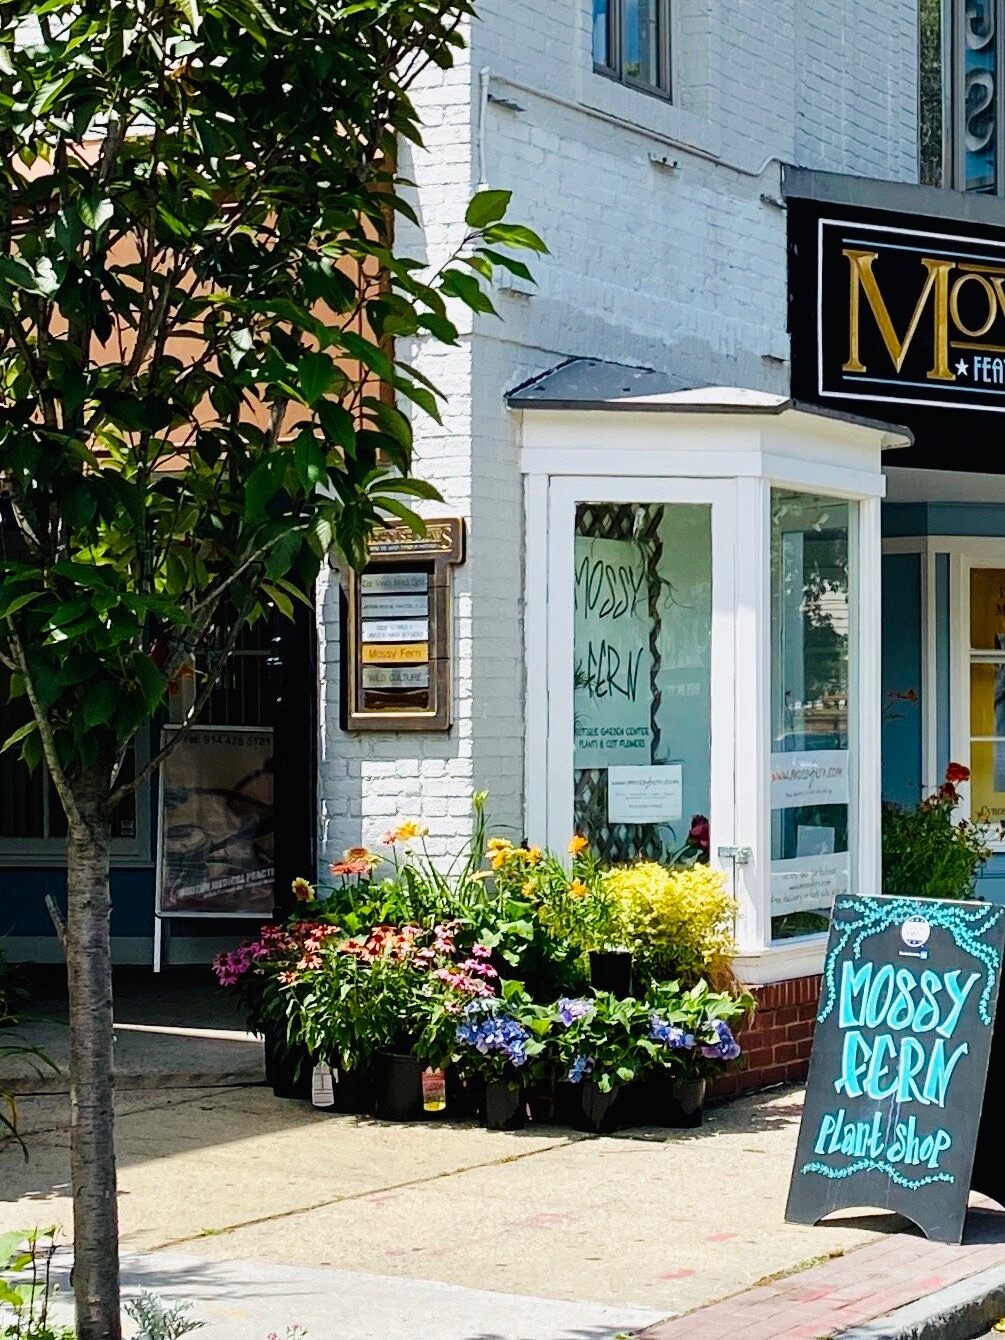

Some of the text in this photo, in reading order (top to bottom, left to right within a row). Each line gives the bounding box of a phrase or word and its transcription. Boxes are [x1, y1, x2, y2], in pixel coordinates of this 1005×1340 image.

[368, 648, 421, 659] Mossy Fern
[587, 639, 643, 702] FERN
[838, 960, 982, 1039] MOSSY
[834, 1030, 969, 1109] FERN
